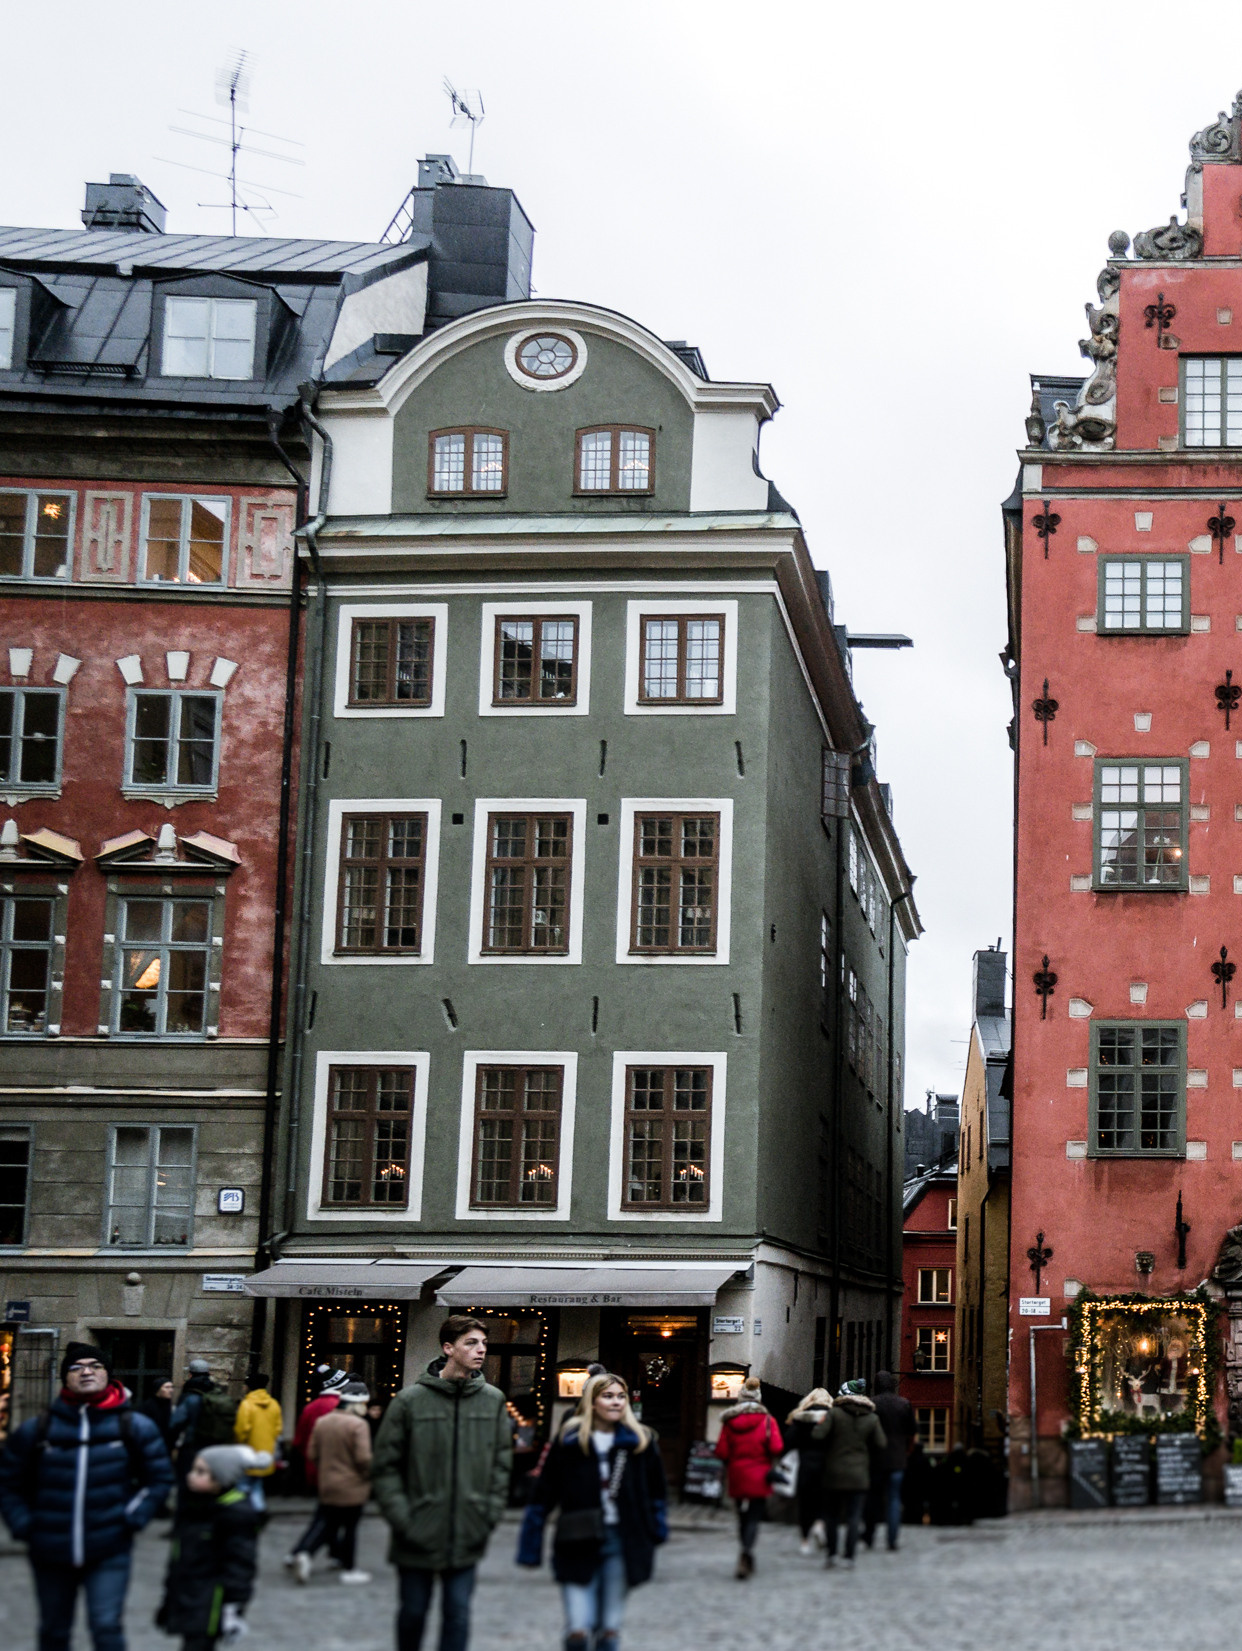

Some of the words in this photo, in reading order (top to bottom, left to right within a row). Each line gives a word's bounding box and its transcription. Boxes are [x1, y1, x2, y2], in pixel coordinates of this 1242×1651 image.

[298, 1286, 323, 1296] Café
[529, 1294, 588, 1305] Restaurang
[590, 1294, 599, 1304] &
[602, 1294, 622, 1304] Bar
